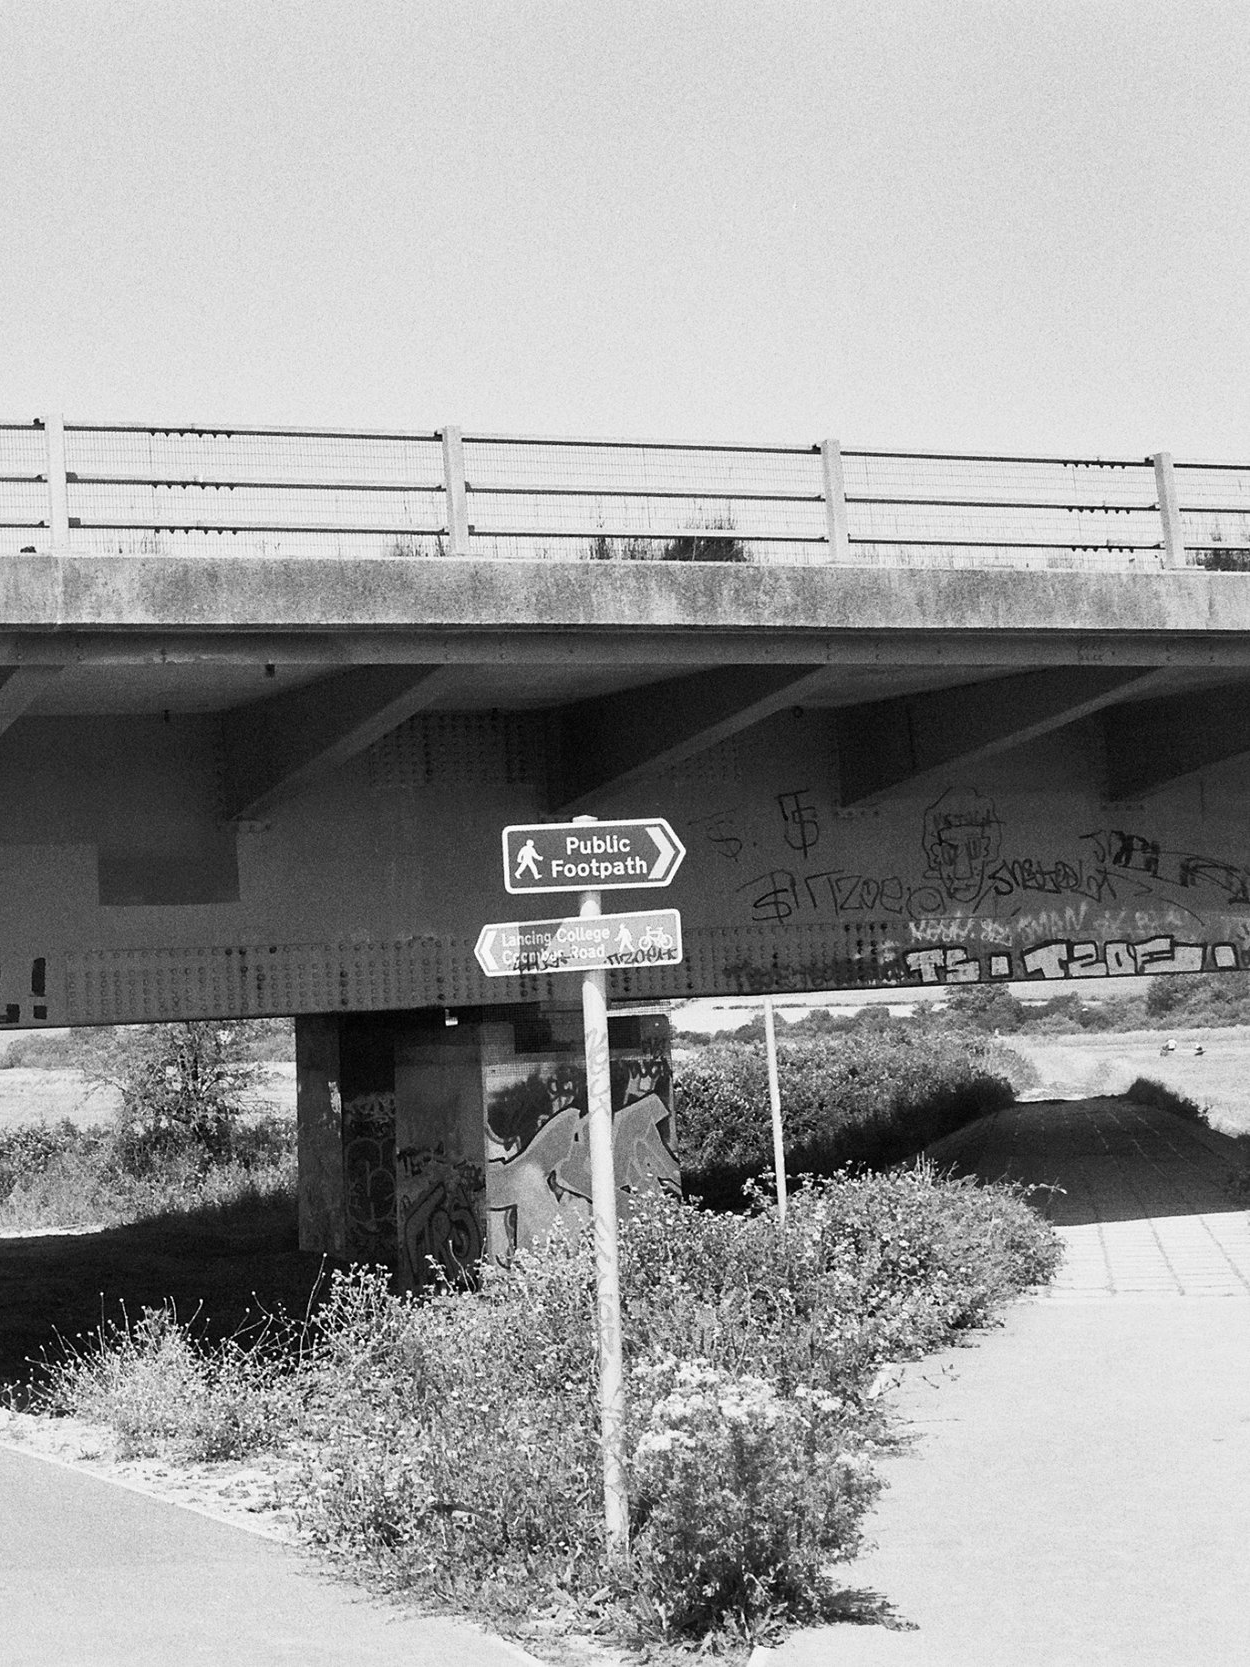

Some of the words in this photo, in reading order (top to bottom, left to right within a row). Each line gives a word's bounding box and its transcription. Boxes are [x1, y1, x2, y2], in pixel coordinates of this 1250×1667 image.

[565, 835, 631, 856] Public
[551, 856, 648, 879] Footpath
[501, 931, 552, 948] Lancing
[556, 926, 611, 944] College
[570, 943, 606, 960] Road
